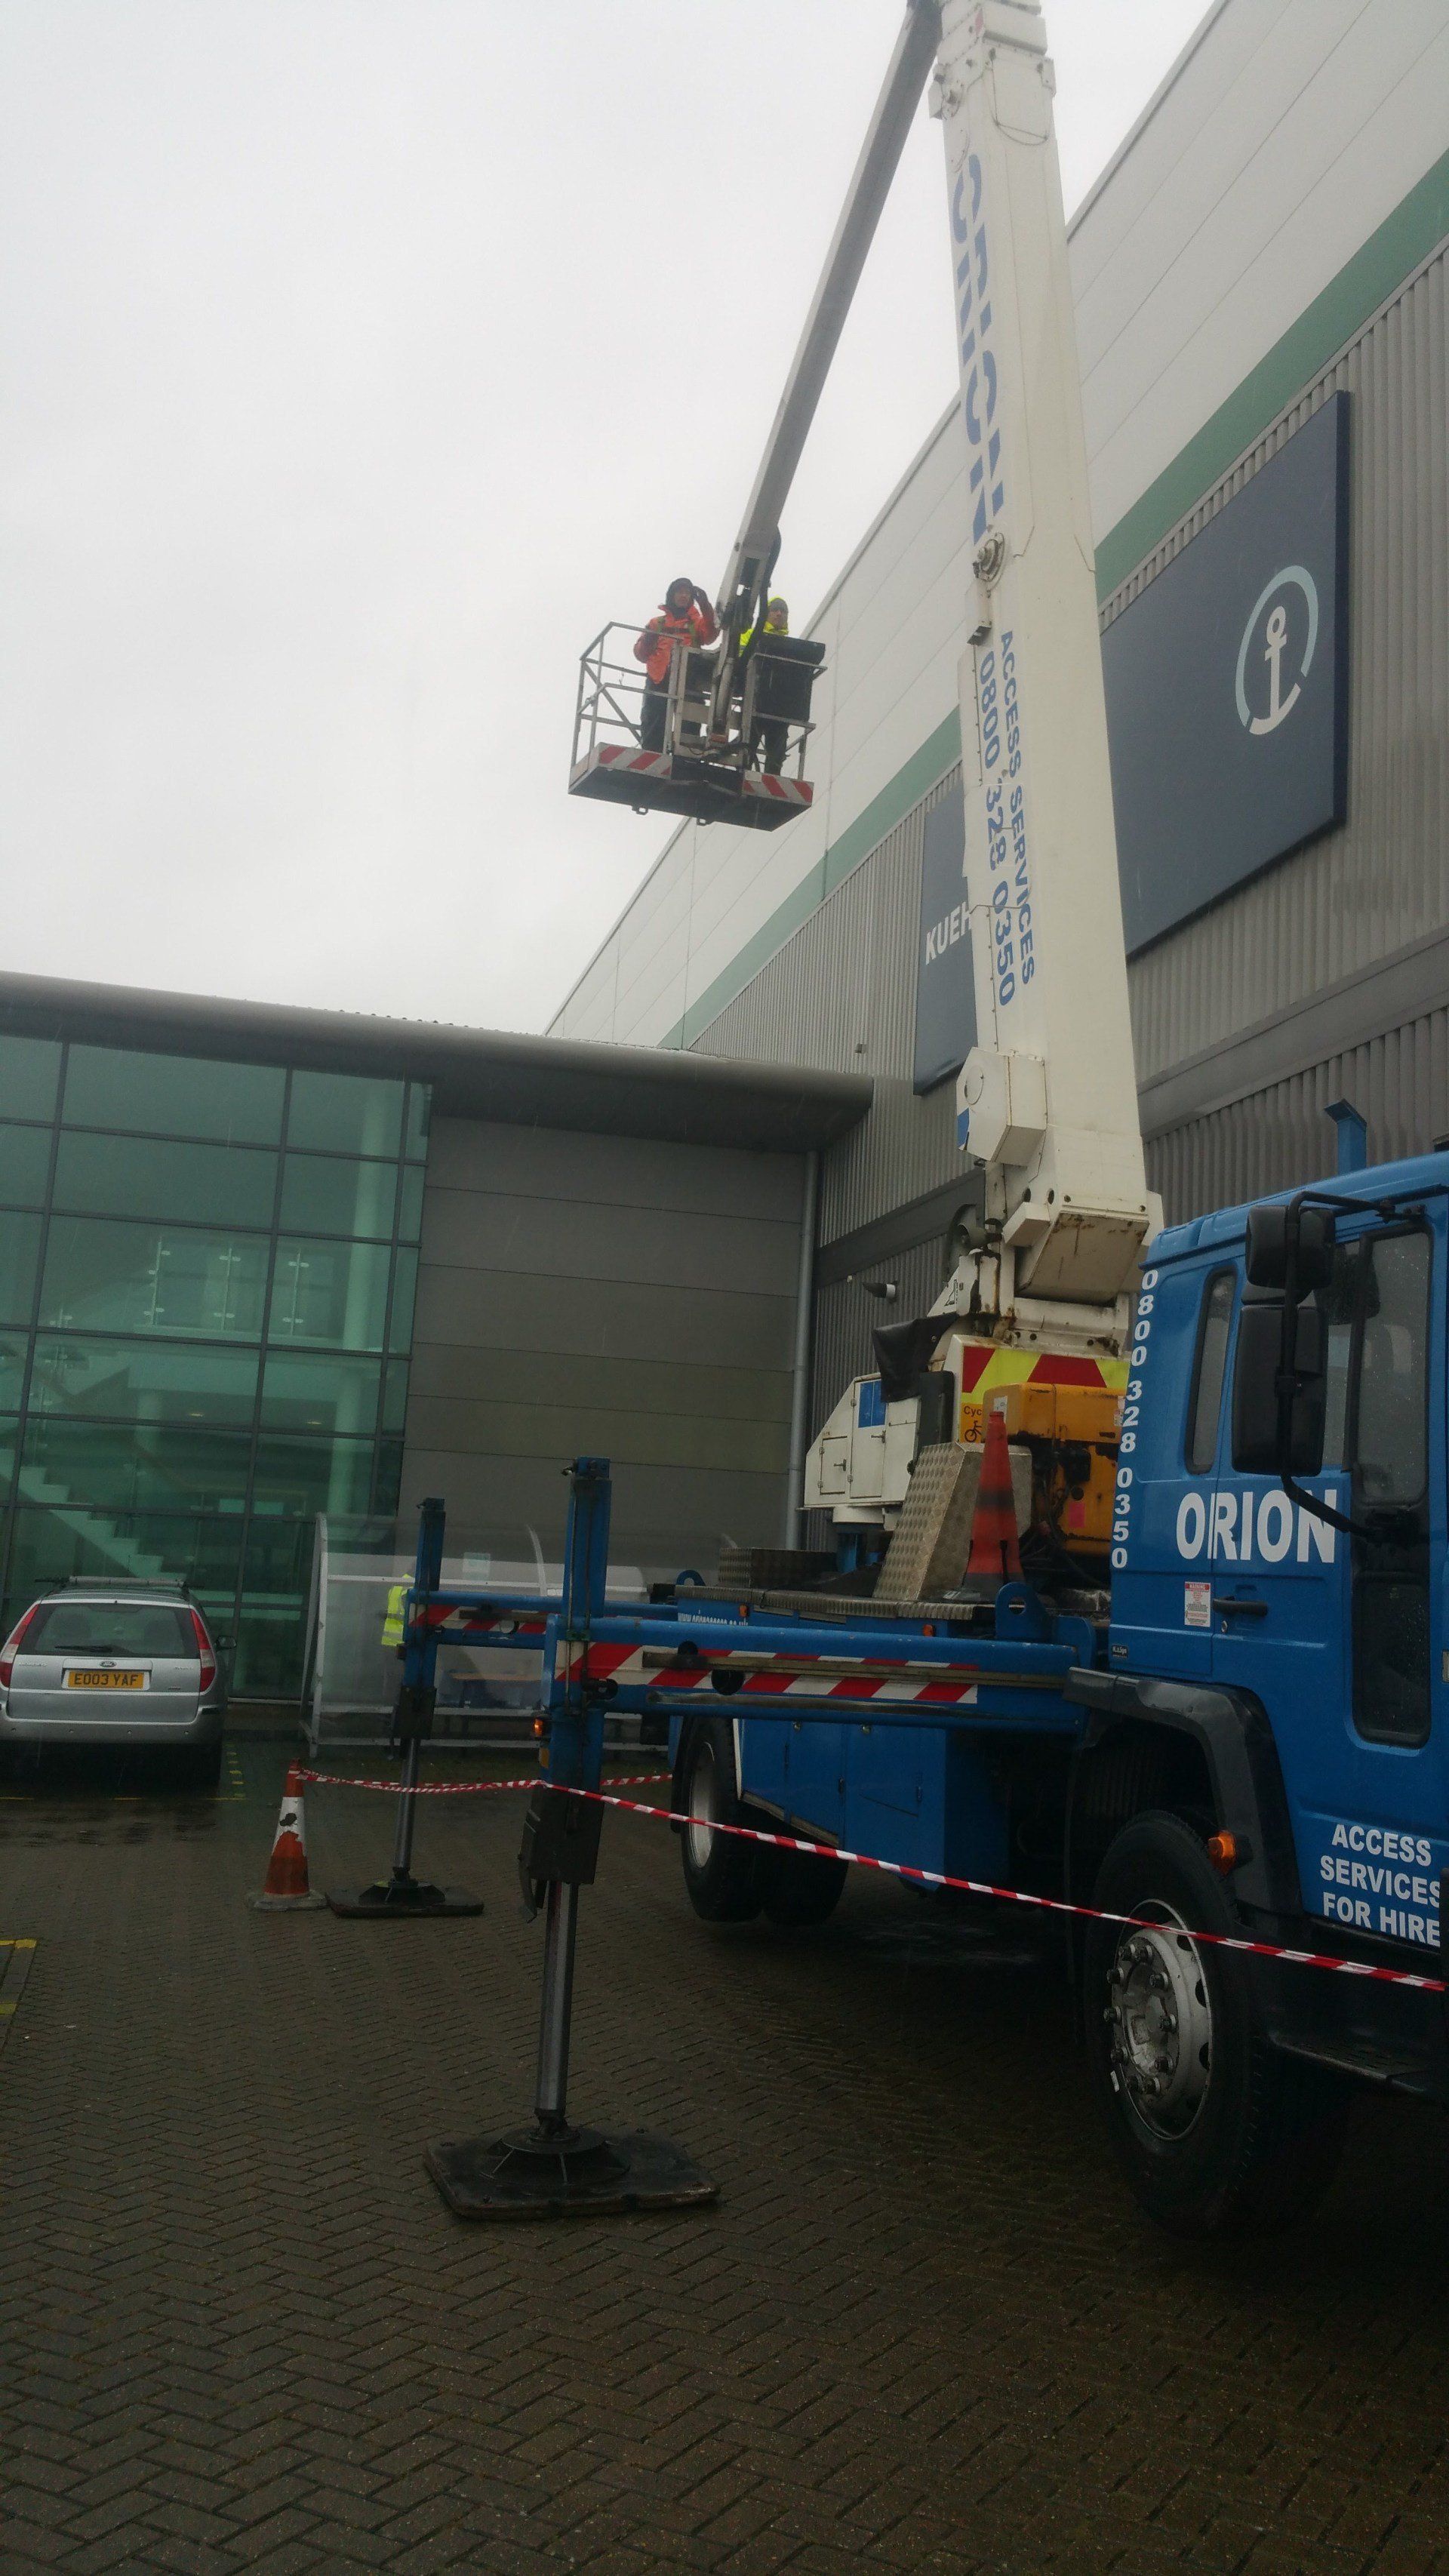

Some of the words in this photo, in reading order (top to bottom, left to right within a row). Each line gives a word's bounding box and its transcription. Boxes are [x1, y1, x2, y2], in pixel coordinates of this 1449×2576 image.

[980, 651, 1000, 768] 0800
[1001, 631, 1021, 777] ACCESS
[986, 777, 1006, 870] 328
[1010, 786, 1034, 984] SERVICES
[992, 881, 1015, 1005] 0350
[1131, 1270, 1158, 1367] 0800
[1120, 1380, 1142, 1453] 328
[1112, 1467, 1133, 1568] 0350
[1176, 1489, 1337, 1563] ORION
[114, 1674, 138, 1686] YAF
[1320, 1855, 1440, 1908] SERVICES
[1331, 1824, 1432, 1867] ACCESS
[1323, 1891, 1371, 1929] FOR
[1380, 1906, 1441, 1947] HIRE
